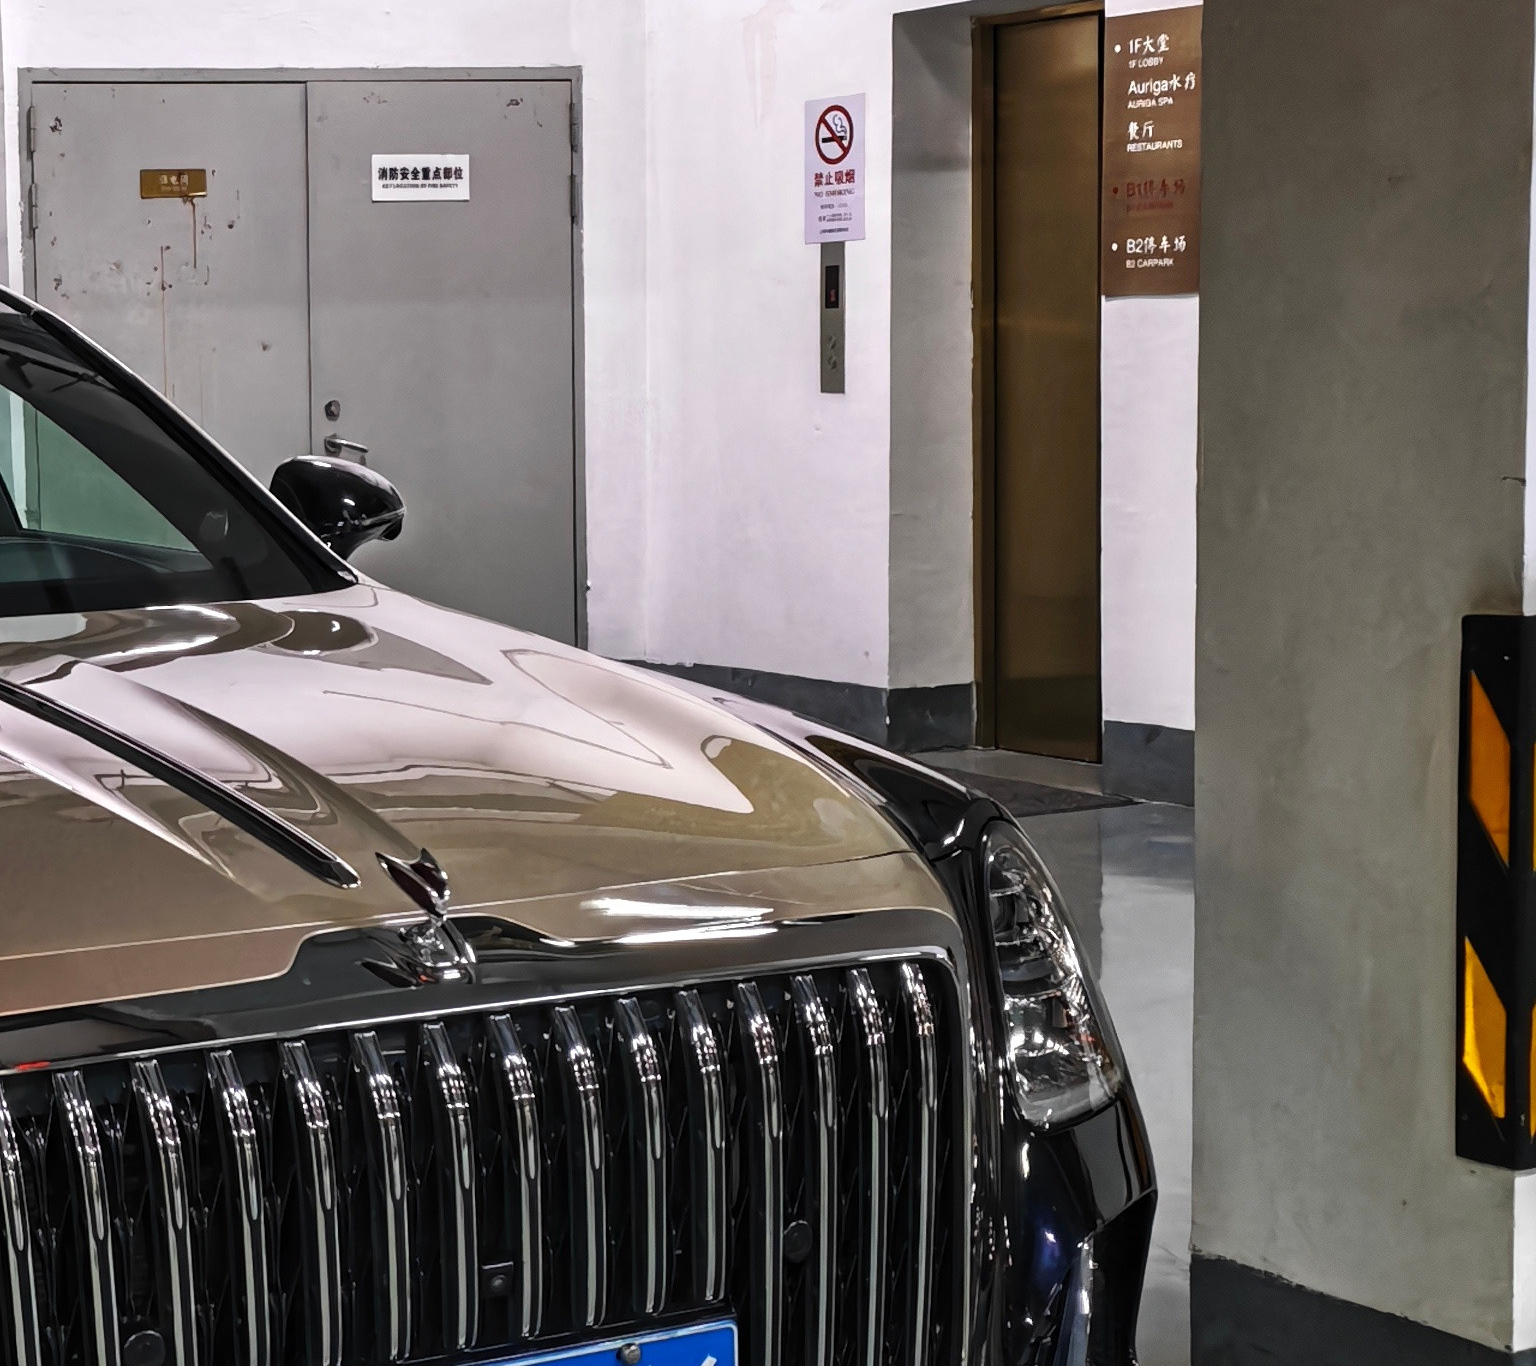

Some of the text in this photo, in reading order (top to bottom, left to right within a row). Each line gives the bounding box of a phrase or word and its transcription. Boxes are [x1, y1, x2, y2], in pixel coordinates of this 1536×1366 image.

[1138, 56, 1164, 68] LOBBY
[1158, 96, 1174, 107] SPA
[1126, 138, 1183, 153] RESTAURANTS
[378, 166, 464, 181] 消防安全重点部位
[814, 168, 855, 187] 禁止吸烟
[1126, 235, 1187, 254] B2停车场
[1137, 257, 1174, 268] CARPARK
